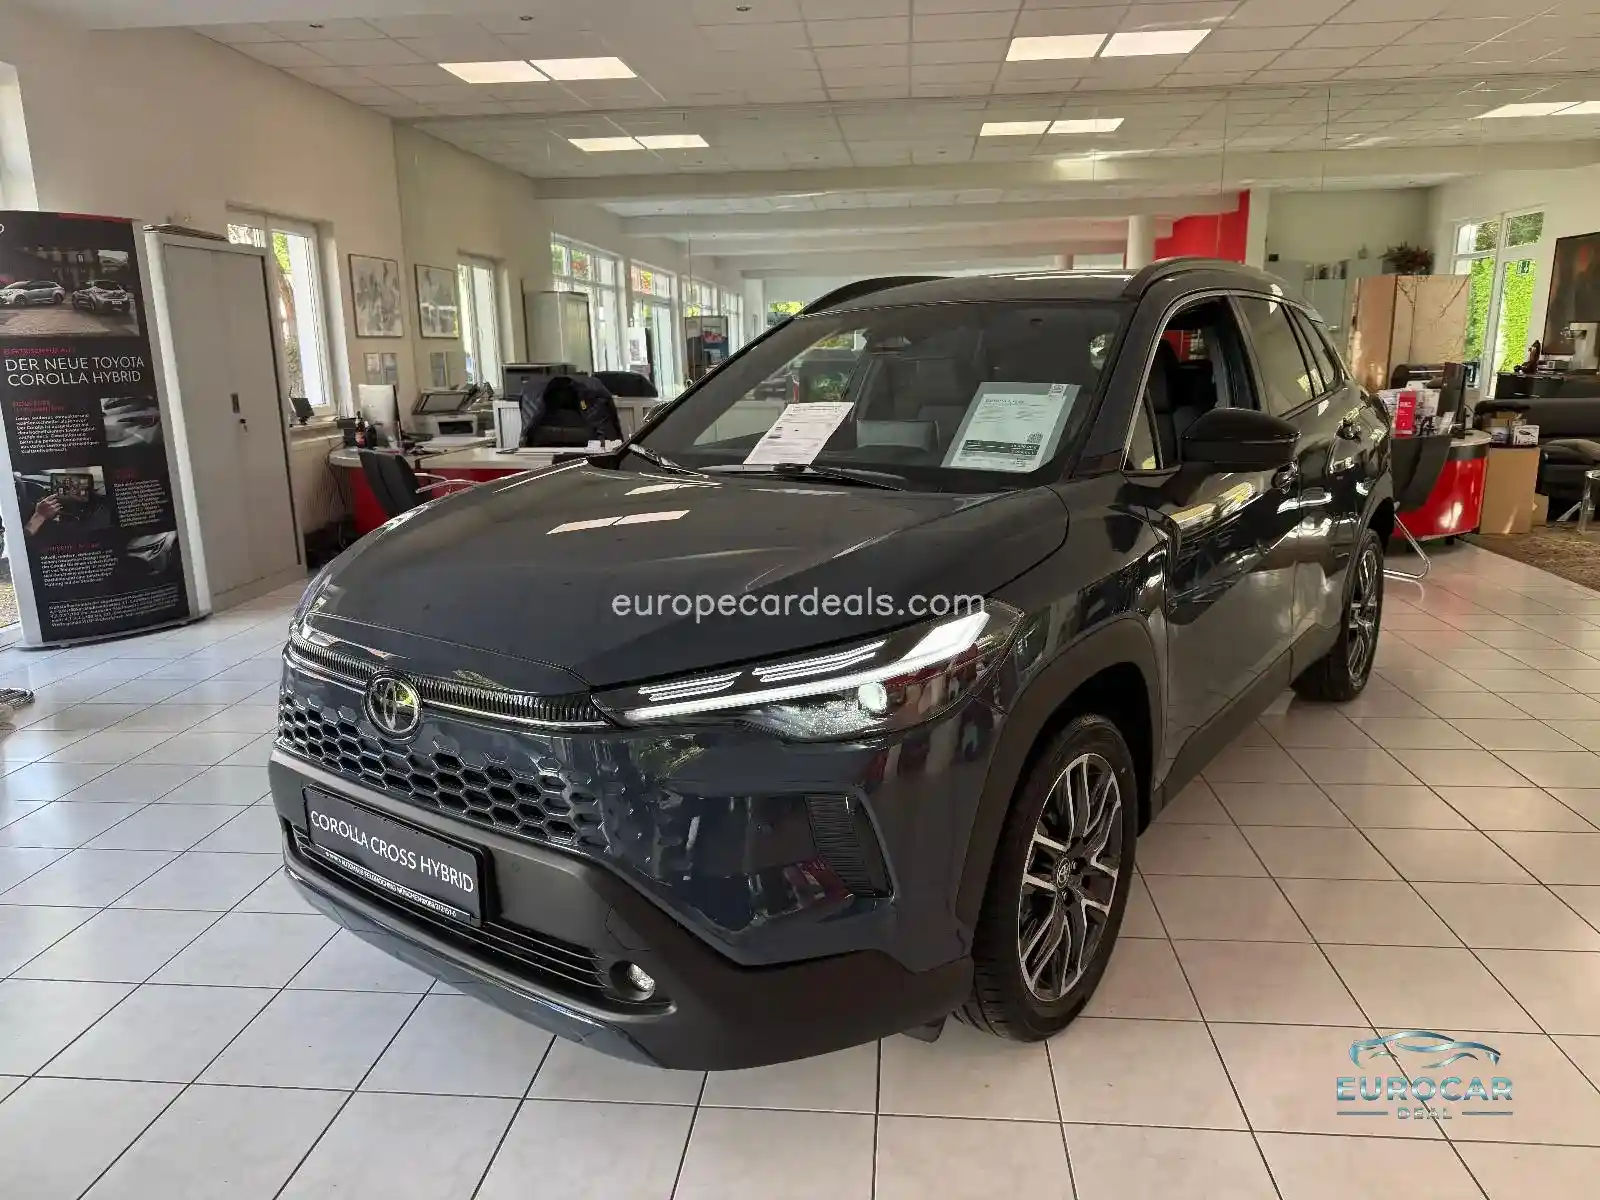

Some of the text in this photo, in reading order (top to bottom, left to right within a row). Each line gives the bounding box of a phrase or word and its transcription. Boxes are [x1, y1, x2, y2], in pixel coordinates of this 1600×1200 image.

[5, 356, 145, 371] DER NEUE TOYOTA
[8, 370, 141, 387] COROLLA HYBRID
[310, 810, 474, 893] COROLLA CROSS HYBRID
